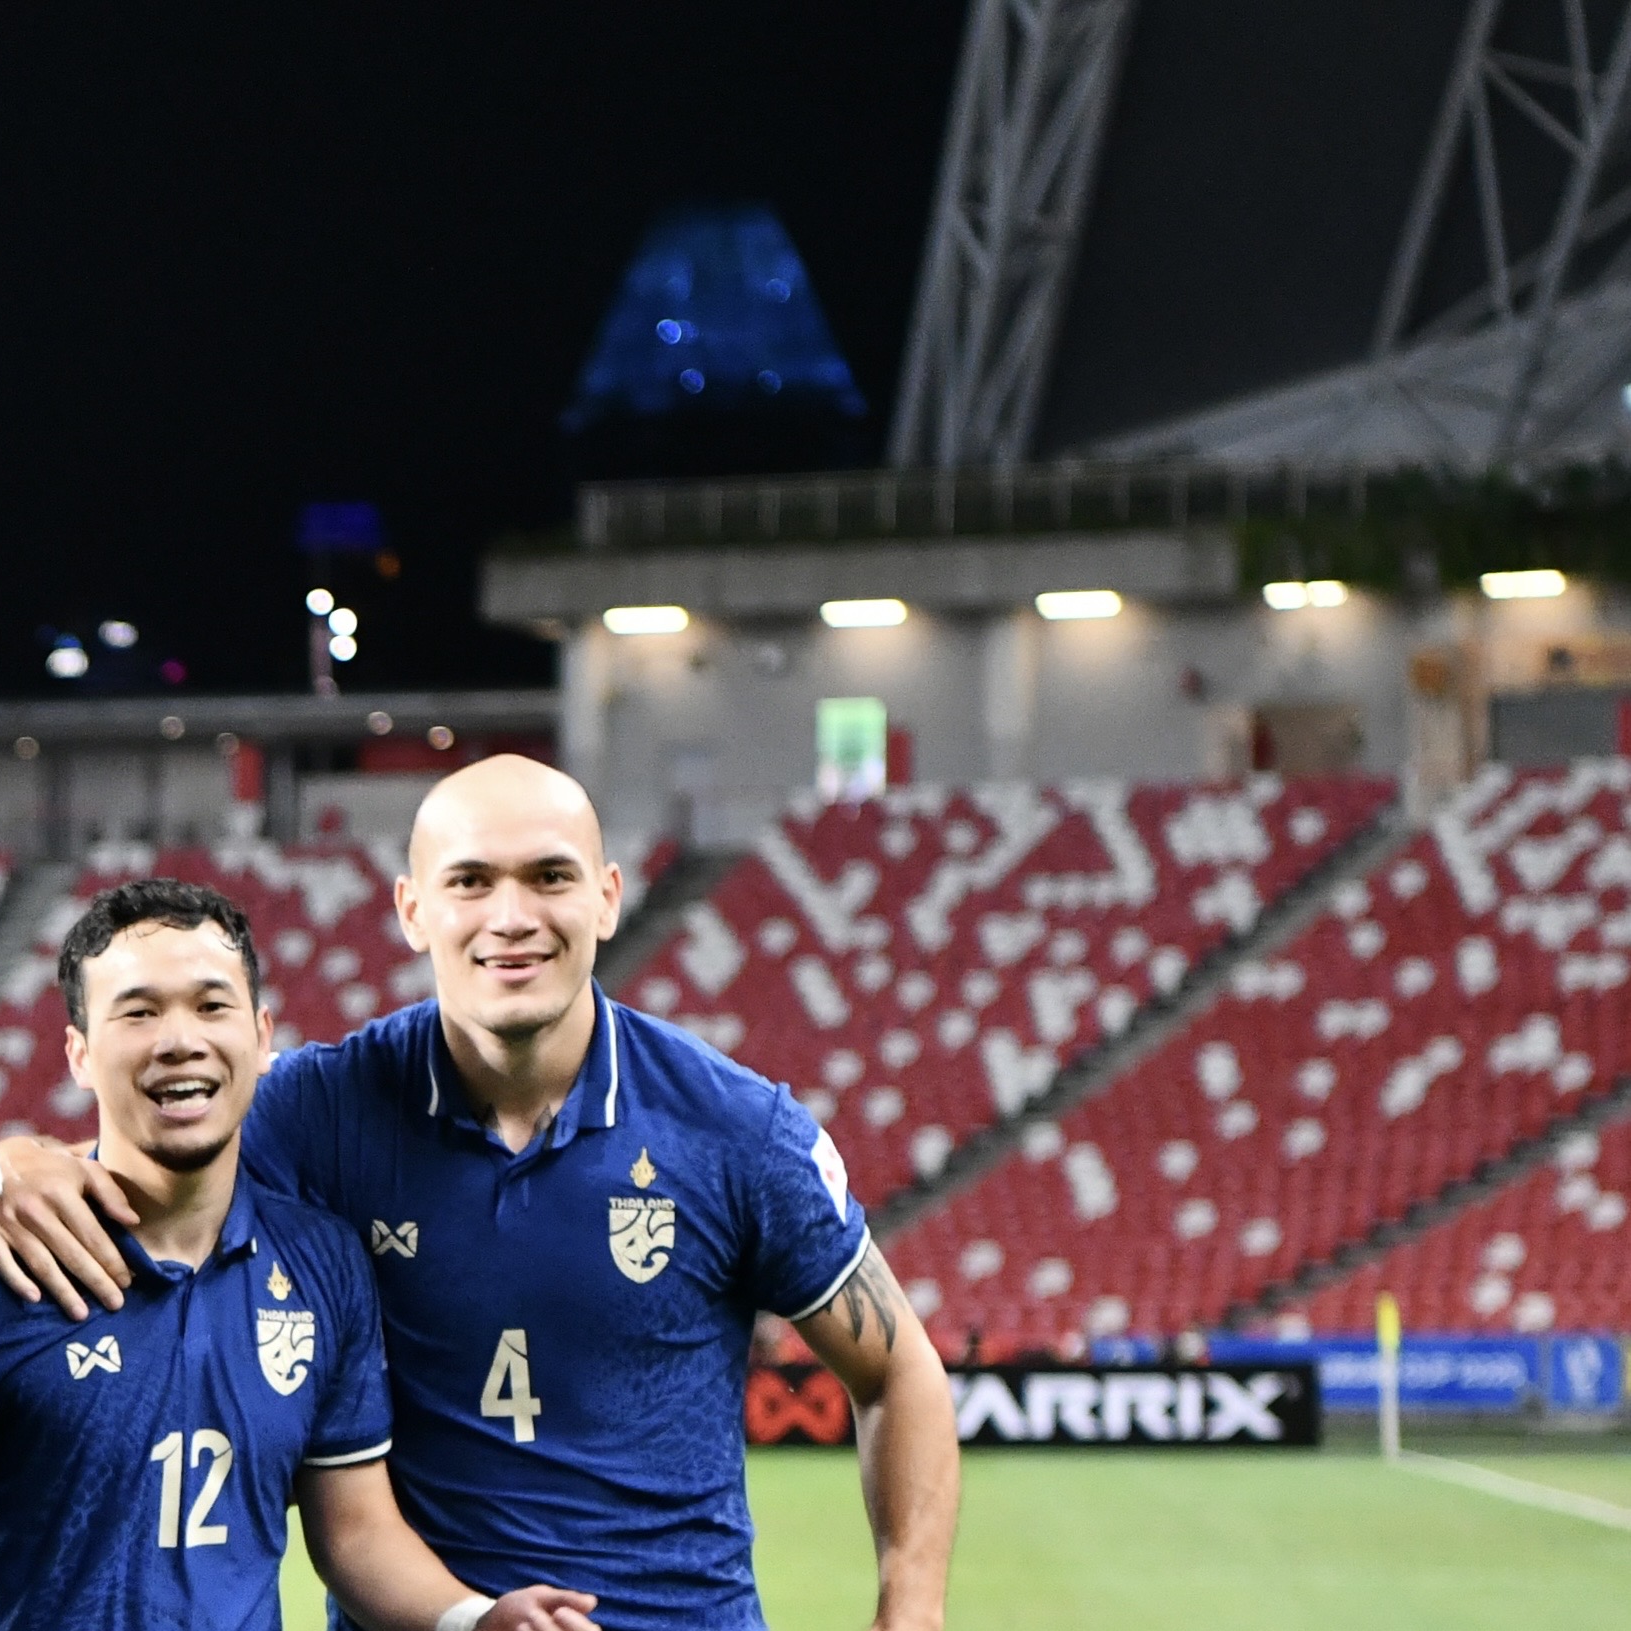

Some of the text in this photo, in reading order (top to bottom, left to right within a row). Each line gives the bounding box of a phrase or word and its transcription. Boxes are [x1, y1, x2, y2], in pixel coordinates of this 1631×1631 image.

[608, 1196, 676, 1211] THAILAND
[257, 1308, 314, 1323] THAILAND
[480, 1329, 542, 1443] 4
[945, 1371, 1288, 1442] ARRIX
[150, 1428, 234, 1549] 12
